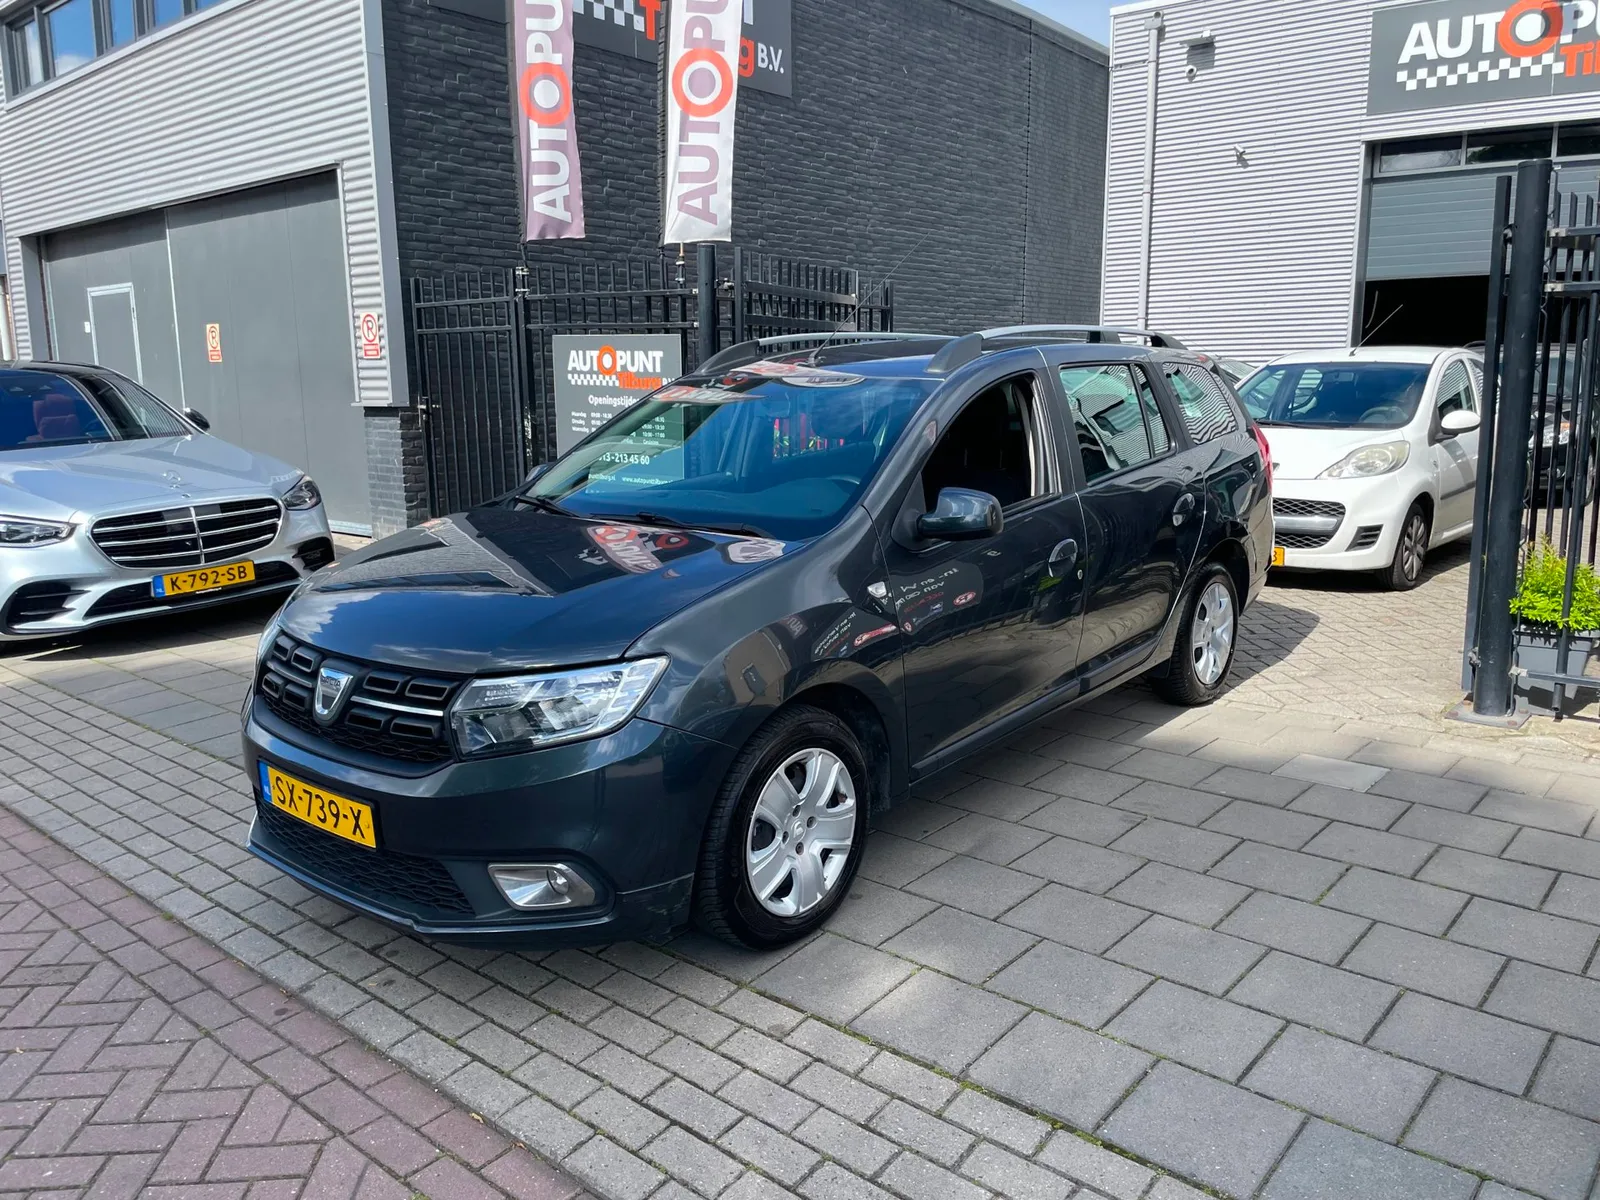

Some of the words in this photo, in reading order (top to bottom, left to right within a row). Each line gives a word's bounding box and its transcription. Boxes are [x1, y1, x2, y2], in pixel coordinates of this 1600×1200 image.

[1397, 0, 1600, 65] AUTOP
[757, 42, 785, 74] B.V.
[567, 345, 664, 374] AUTOPUNT
[629, 454, 639, 464] 45
[640, 455, 650, 465] 60
[170, 565, 248, 591] K-792-SB
[275, 776, 366, 839] SX-739-X
